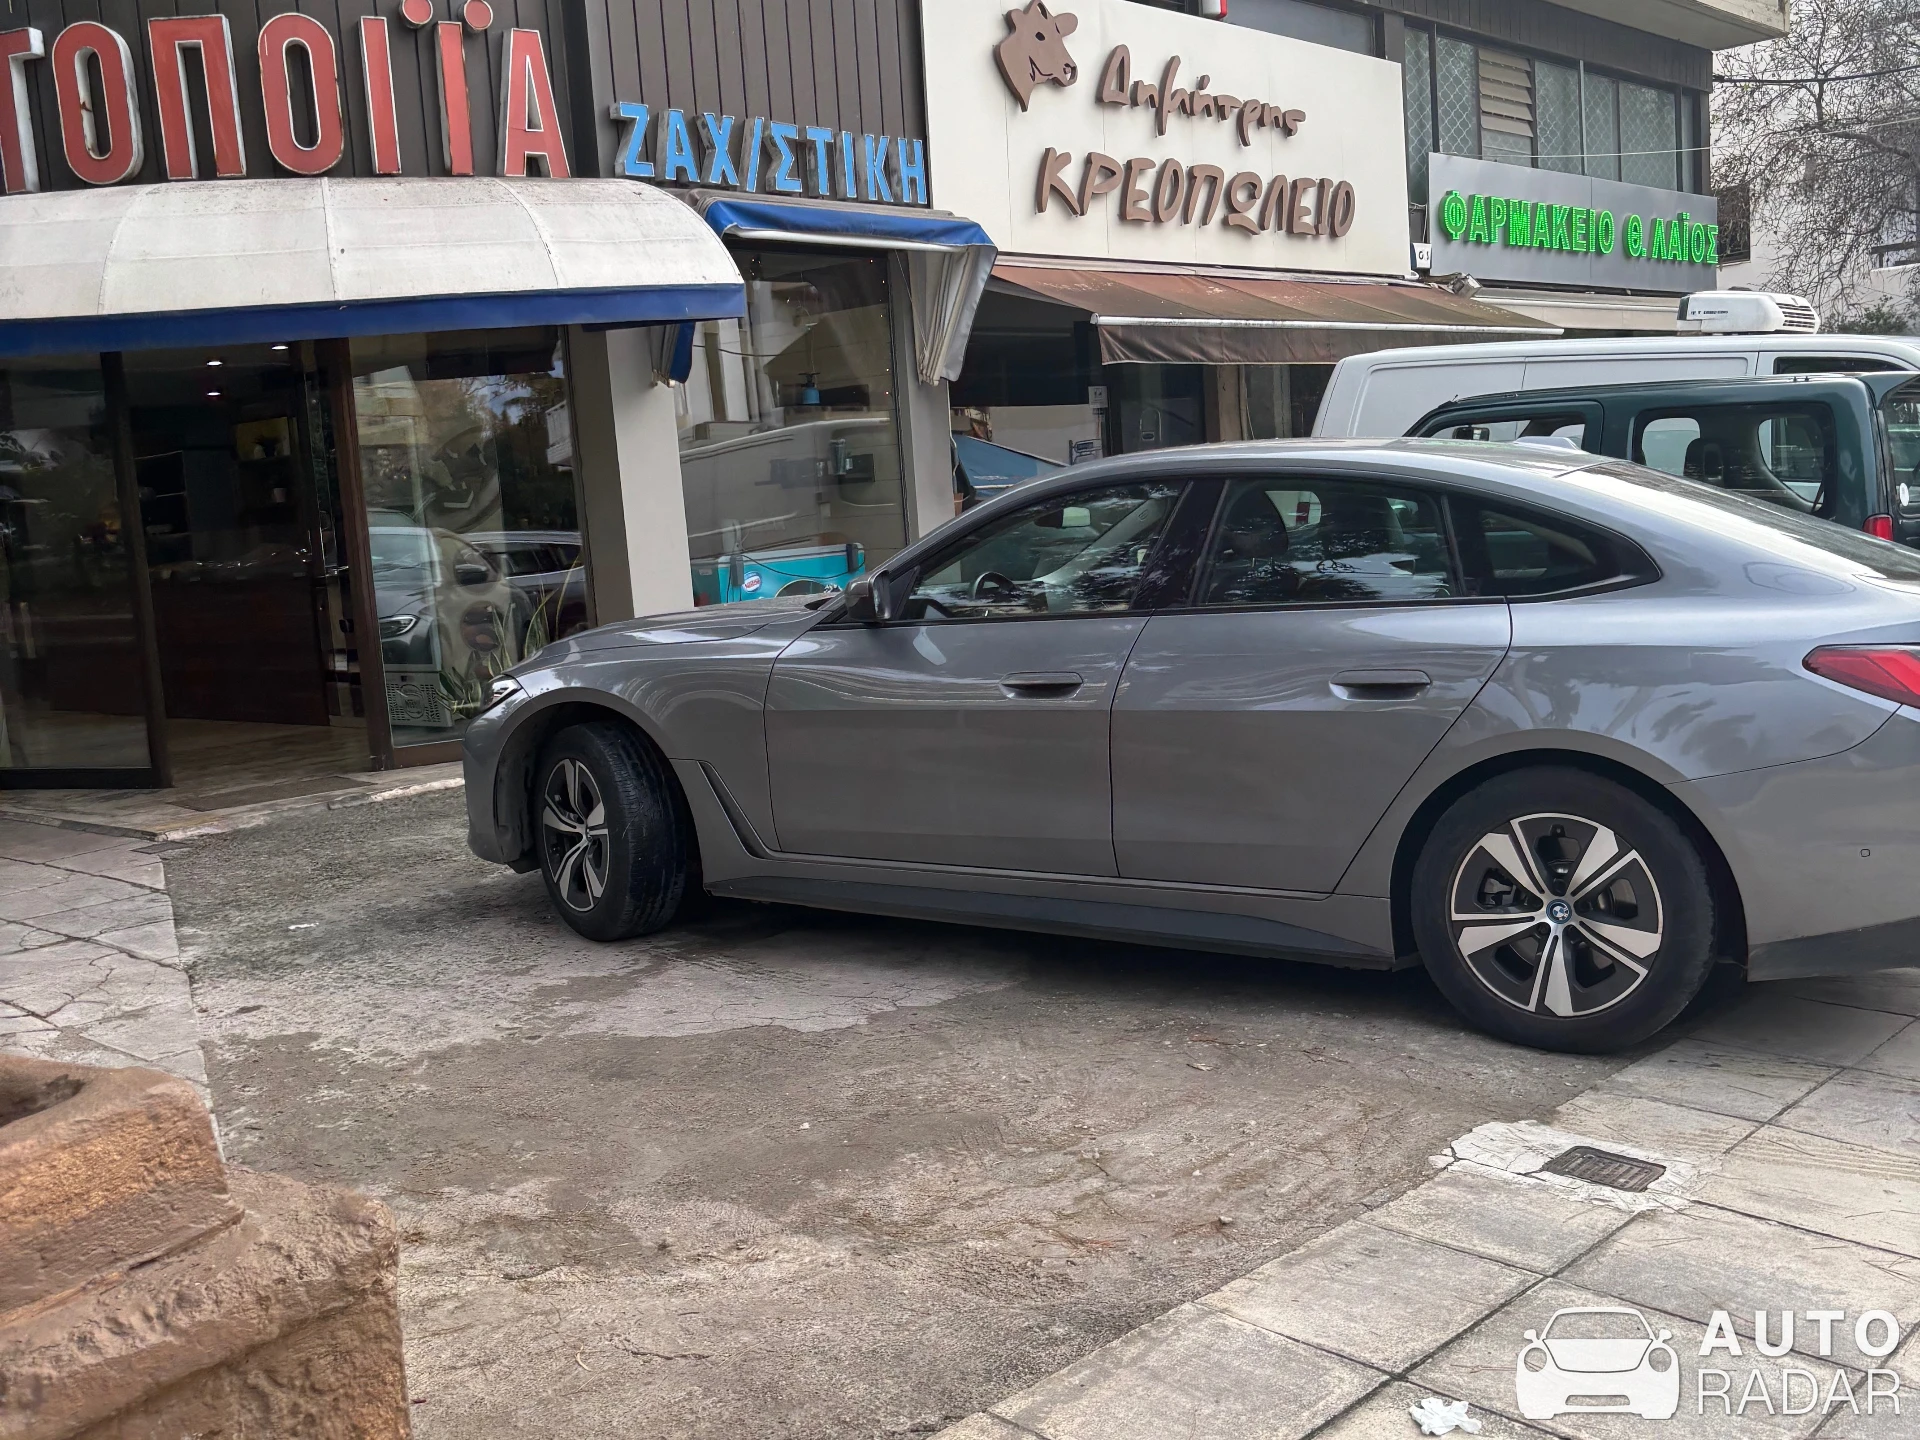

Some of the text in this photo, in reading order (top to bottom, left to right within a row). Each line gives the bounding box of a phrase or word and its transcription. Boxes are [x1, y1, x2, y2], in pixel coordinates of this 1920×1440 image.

[1098, 44, 1306, 147] Δημήτρης
[1034, 147, 1356, 238] ΚΡΕΟΠΩΛΕΙΟ
[1439, 190, 1615, 254] ΦΑΡΜΑΚΕΙΟ
[1650, 211, 1719, 264] ΛΑΪΟΣ
